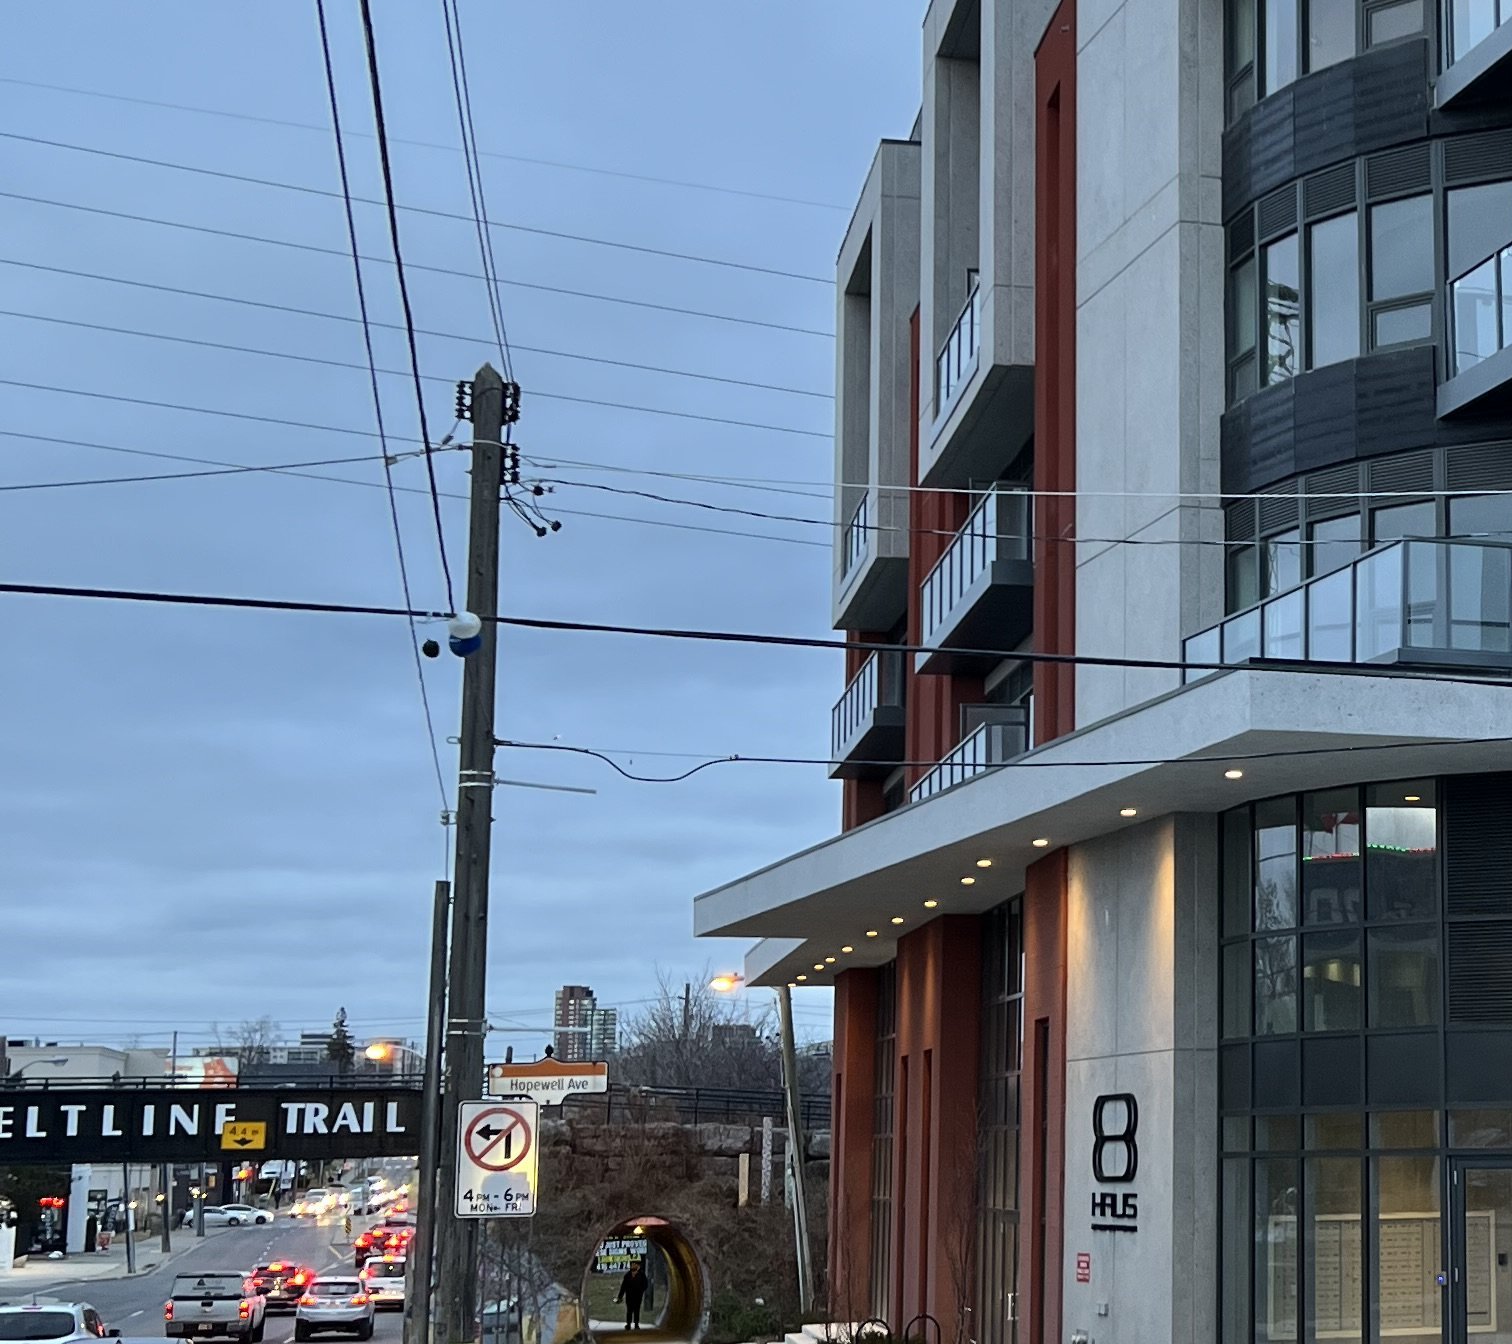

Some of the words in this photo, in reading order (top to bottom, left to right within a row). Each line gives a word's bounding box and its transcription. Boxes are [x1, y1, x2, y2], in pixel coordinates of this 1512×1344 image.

[510, 1078, 565, 1093] Hopewell
[567, 1078, 589, 1090] Ave
[281, 1100, 406, 1134] TRAIL
[1092, 1092, 1139, 1183] 8
[1091, 1192, 1138, 1219] HAUS
